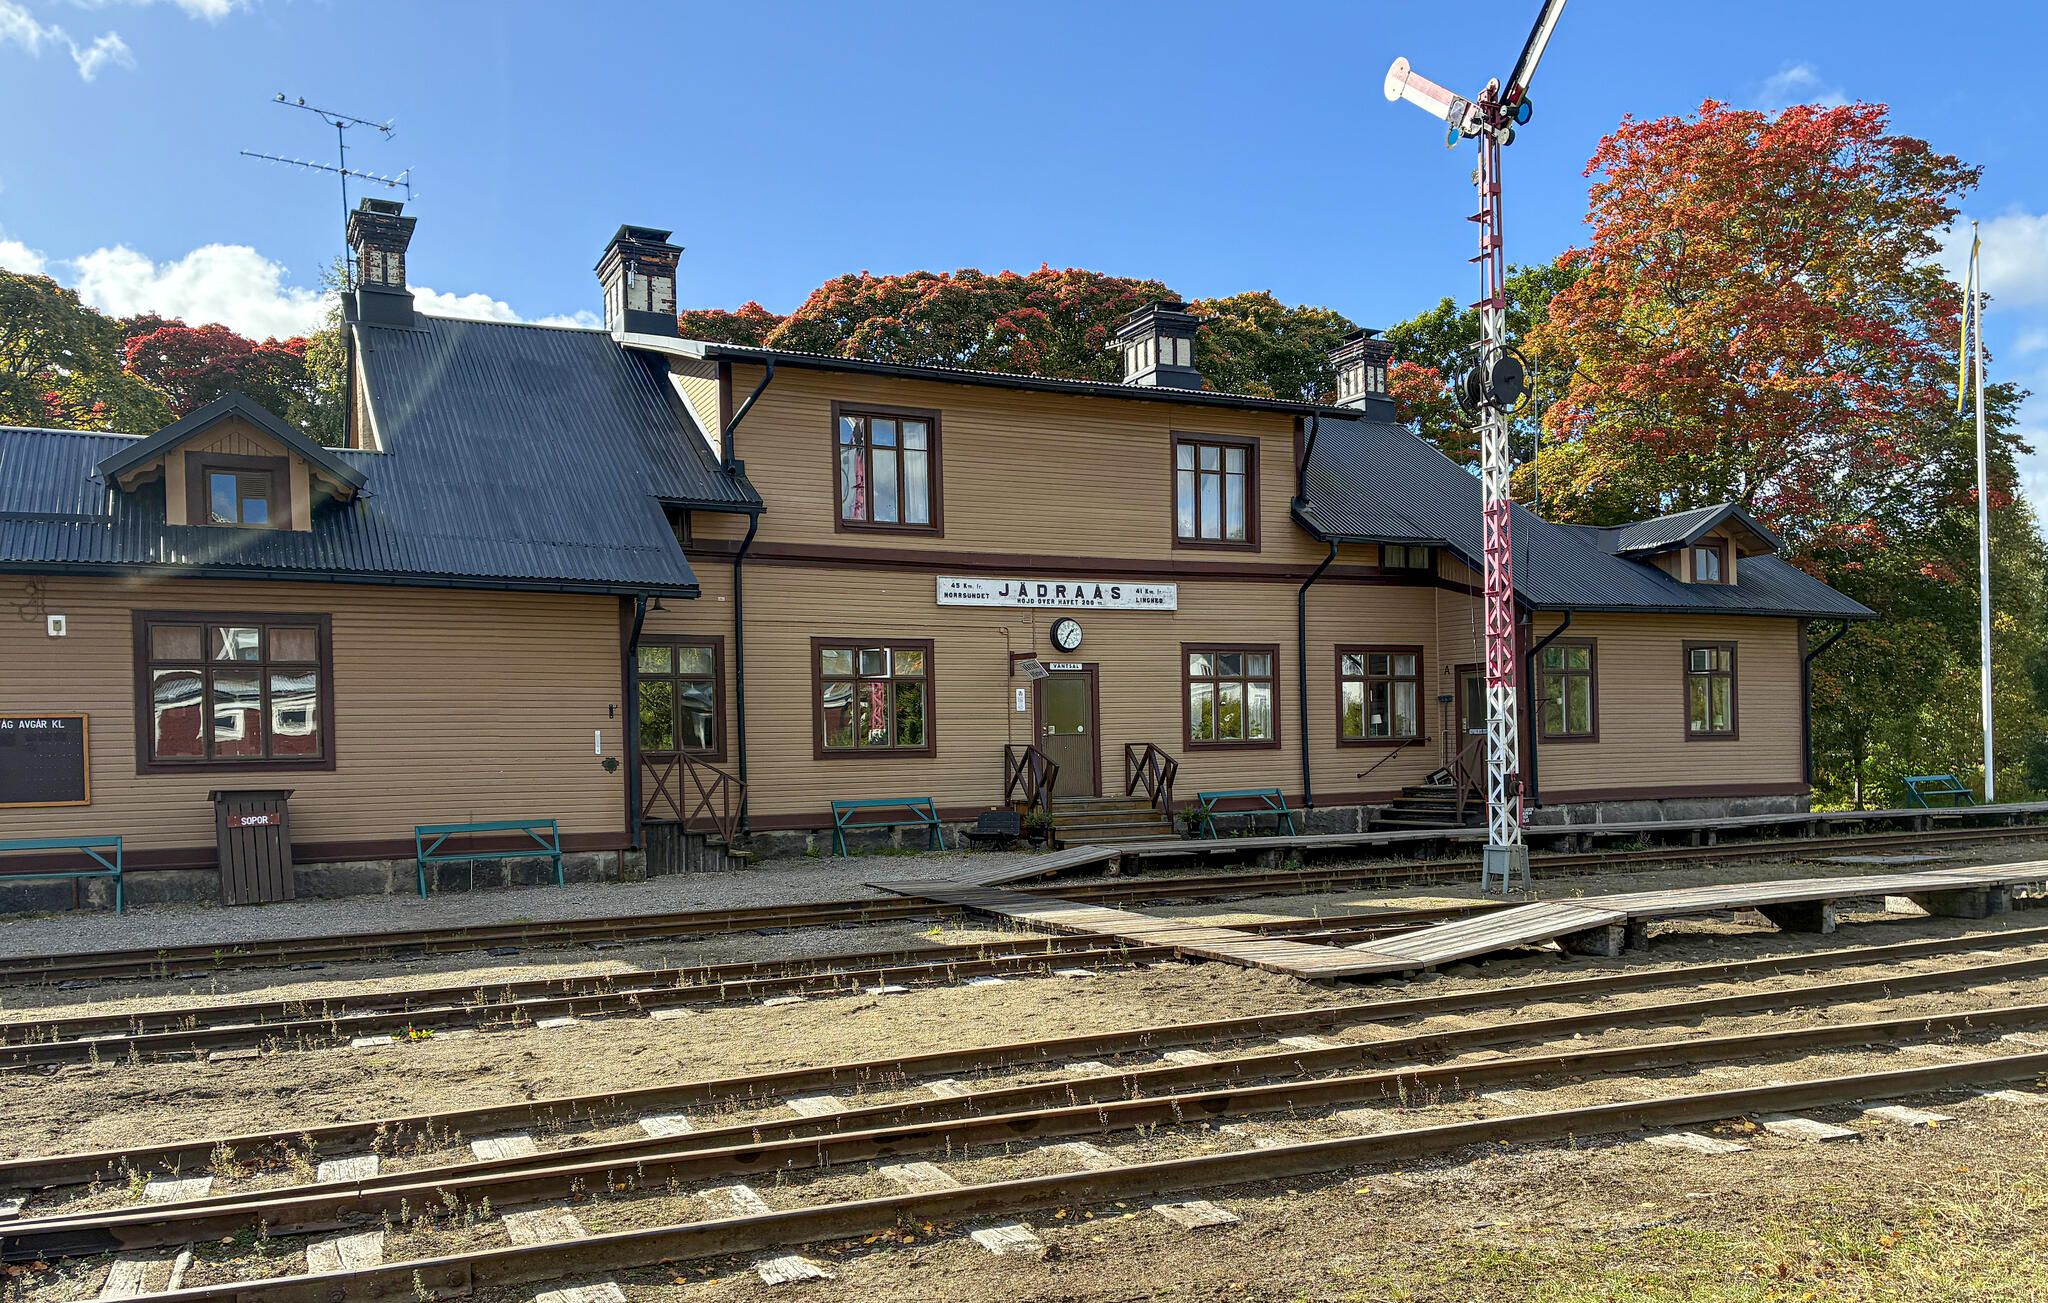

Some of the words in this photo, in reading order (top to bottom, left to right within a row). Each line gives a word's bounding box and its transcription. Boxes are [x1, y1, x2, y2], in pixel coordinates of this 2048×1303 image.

[998, 581, 1121, 600] JÄDRAÅS
[0, 718, 14, 728] ÅG
[18, 718, 47, 728] AVGÅR
[51, 719, 64, 728] KL
[240, 815, 269, 826] SOPOR
